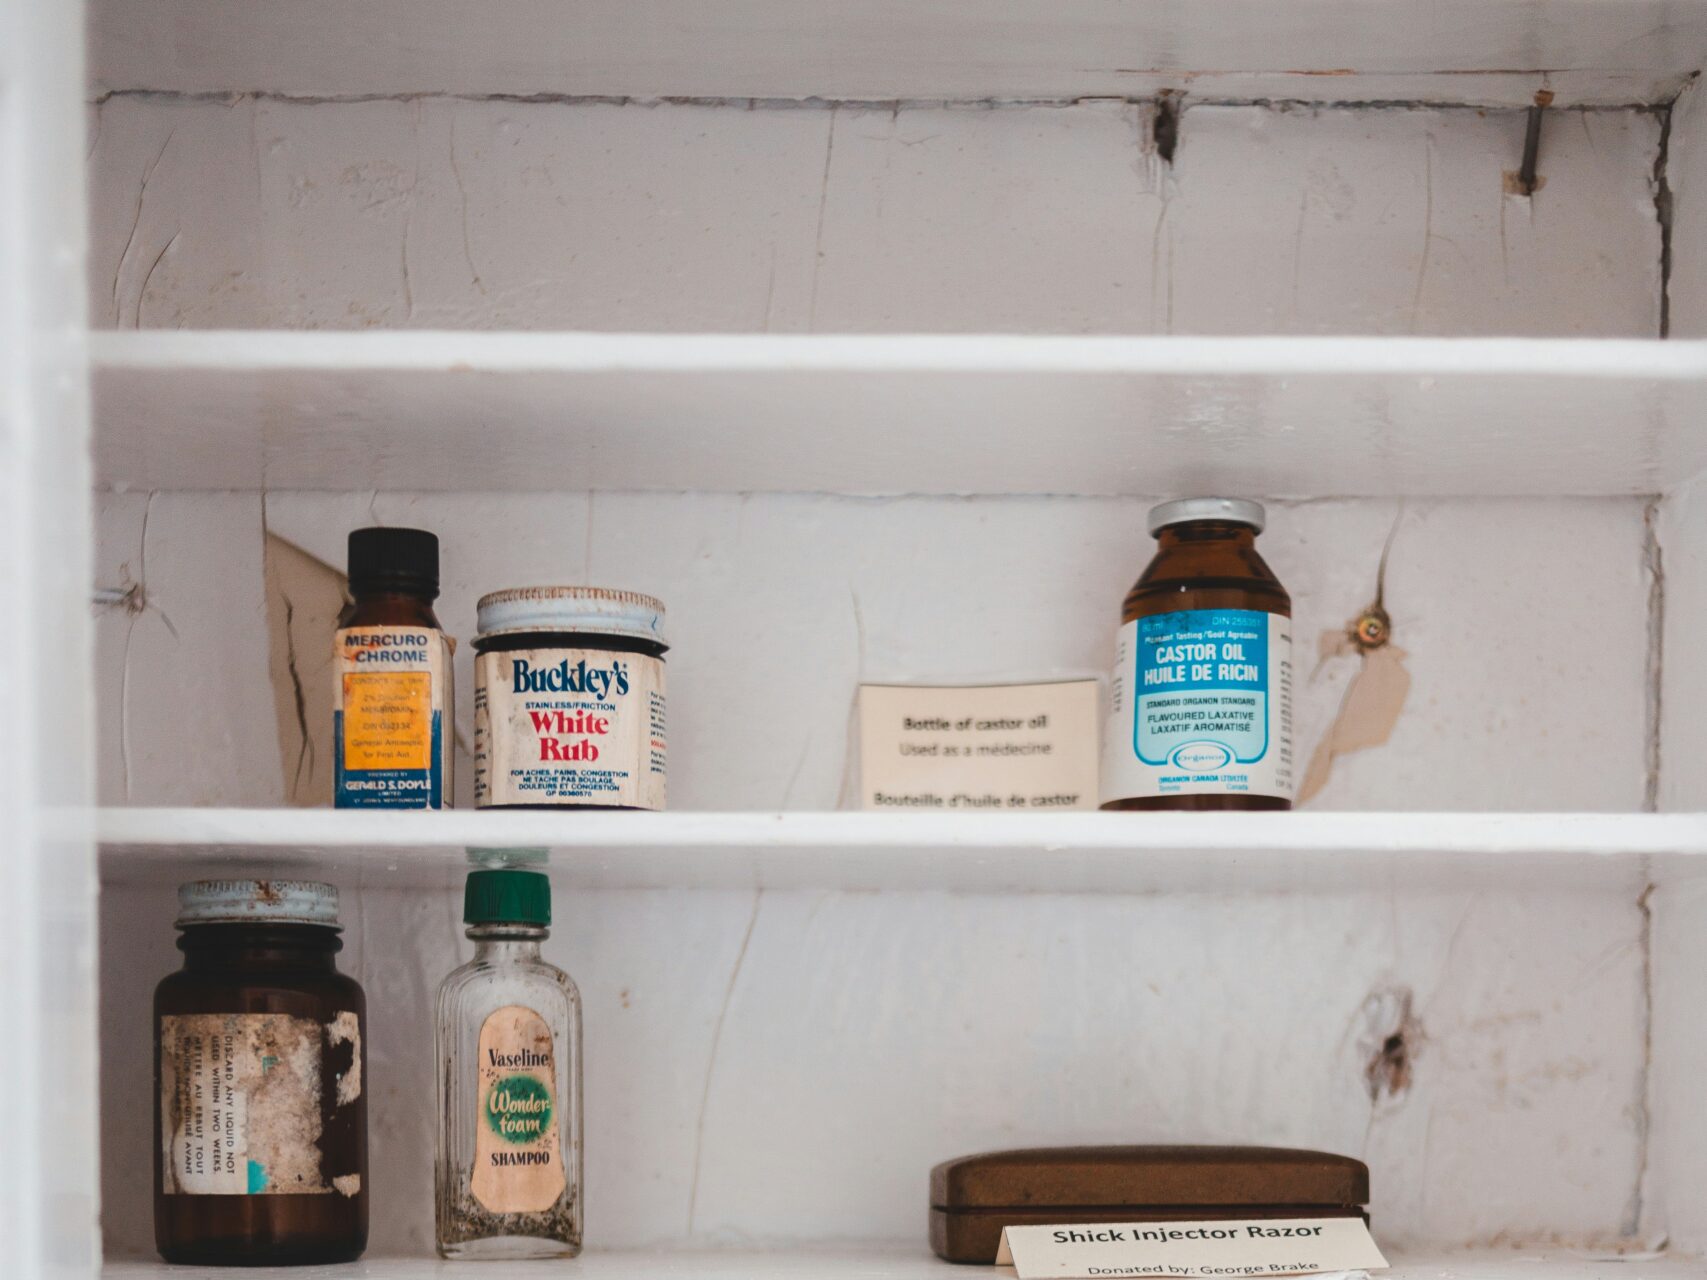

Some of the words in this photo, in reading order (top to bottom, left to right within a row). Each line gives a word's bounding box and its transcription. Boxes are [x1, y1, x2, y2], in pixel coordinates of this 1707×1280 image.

[1212, 617, 1230, 626] DIN
[345, 634, 428, 646] MERCURO
[356, 650, 428, 662] CHROME
[1156, 644, 1218, 664] CASTOR
[1222, 644, 1246, 661] OIL
[512, 658, 629, 700] Buckley's
[1144, 666, 1188, 686] HUILE
[1192, 666, 1212, 681] DE
[1218, 665, 1258, 682] RICIN
[525, 702, 616, 712] STAINLESS/FRICTION
[1147, 698, 1181, 708] STANDARD
[1182, 698, 1218, 706] ORGANON
[1221, 697, 1255, 706] STANDARD
[529, 710, 609, 736] White
[903, 716, 950, 731] Bottle
[955, 718, 973, 731] of
[975, 718, 1023, 731] castor
[1028, 714, 1048, 729] oil
[1148, 712, 1206, 723] FLAVOURED
[1208, 712, 1254, 721] LAXATIVE
[1151, 724, 1190, 734] LAXATIF
[540, 738, 600, 762] Rub
[898, 743, 938, 756] Used
[942, 746, 958, 756] as
[962, 746, 972, 756] a
[580, 770, 629, 778] CONGESTION
[346, 780, 386, 790] GERALD
[398, 780, 432, 790] DOYLE
[572, 784, 620, 792] CONGESTION
[874, 793, 943, 808] Bouteille
[949, 793, 1001, 808] d'huile
[1007, 793, 1025, 807] de
[1030, 793, 1080, 807] castor
[211, 1036, 220, 1061] USED
[225, 1036, 234, 1080] DISCARD
[488, 1049, 550, 1068] Vaseline
[195, 1084, 202, 1098] AU
[212, 1068, 220, 1103] WITHIN
[226, 1086, 234, 1107] ANY
[212, 1109, 220, 1132] TWO
[499, 1114, 540, 1135] foam
[226, 1112, 234, 1148] LIQUID
[196, 1146, 204, 1176] TOUT
[226, 1152, 234, 1174] NOT
[491, 1151, 550, 1166] SHAMPOO
[1053, 1230, 1125, 1244] Shick
[1133, 1226, 1238, 1244] Injector
[1246, 1224, 1323, 1238] Razor
[1088, 1264, 1164, 1276] Donated
[1168, 1264, 1196, 1276] by:
[1200, 1264, 1264, 1275] George
[1270, 1261, 1320, 1272] Brake
